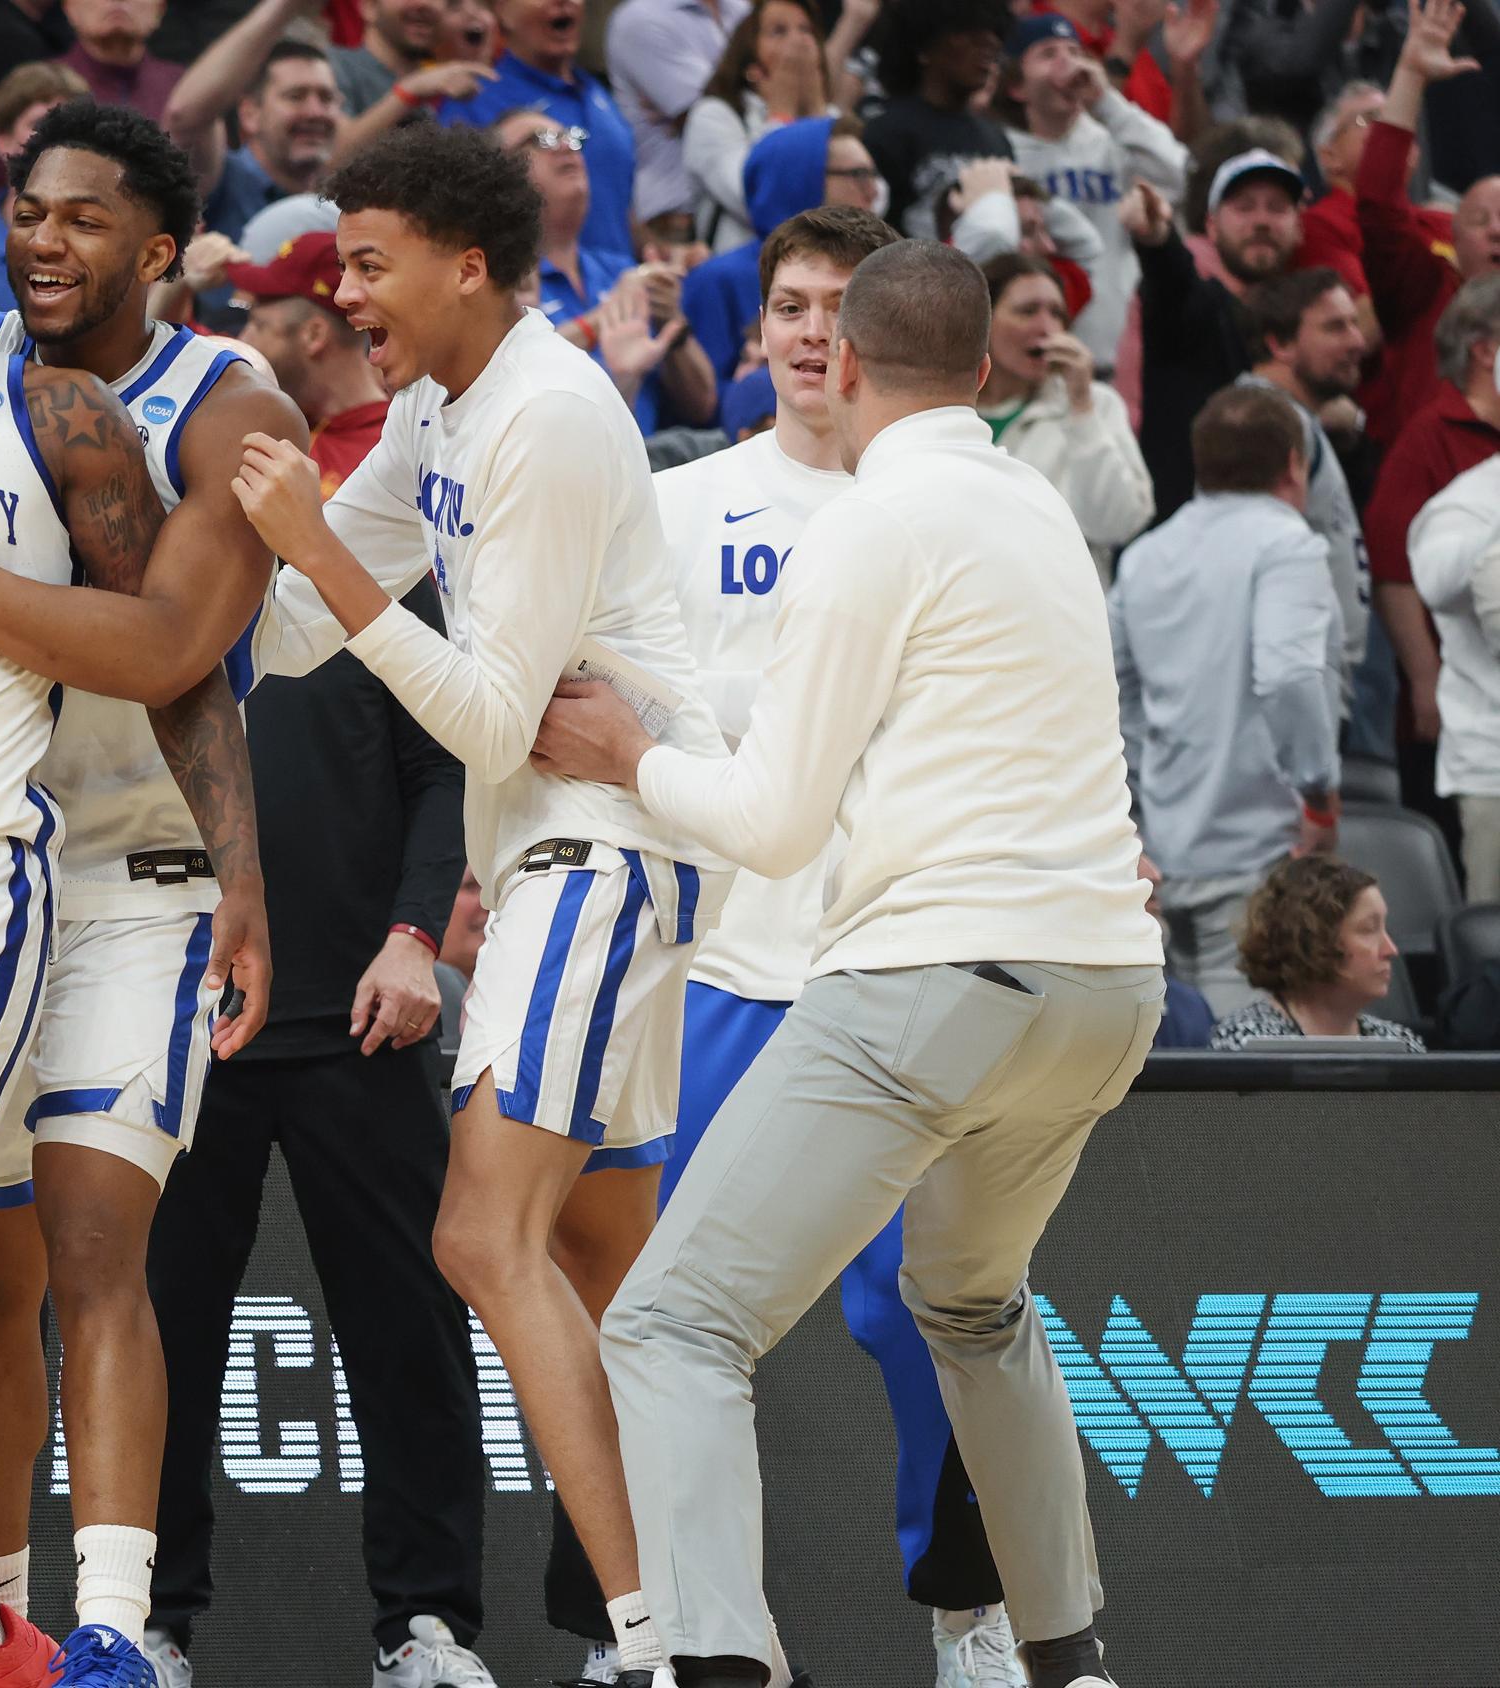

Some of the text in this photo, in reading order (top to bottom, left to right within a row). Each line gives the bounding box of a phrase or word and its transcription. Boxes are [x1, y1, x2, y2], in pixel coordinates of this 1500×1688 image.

[721, 543, 794, 596] LO
[559, 846, 575, 857] 48
[190, 857, 205, 869] 48
